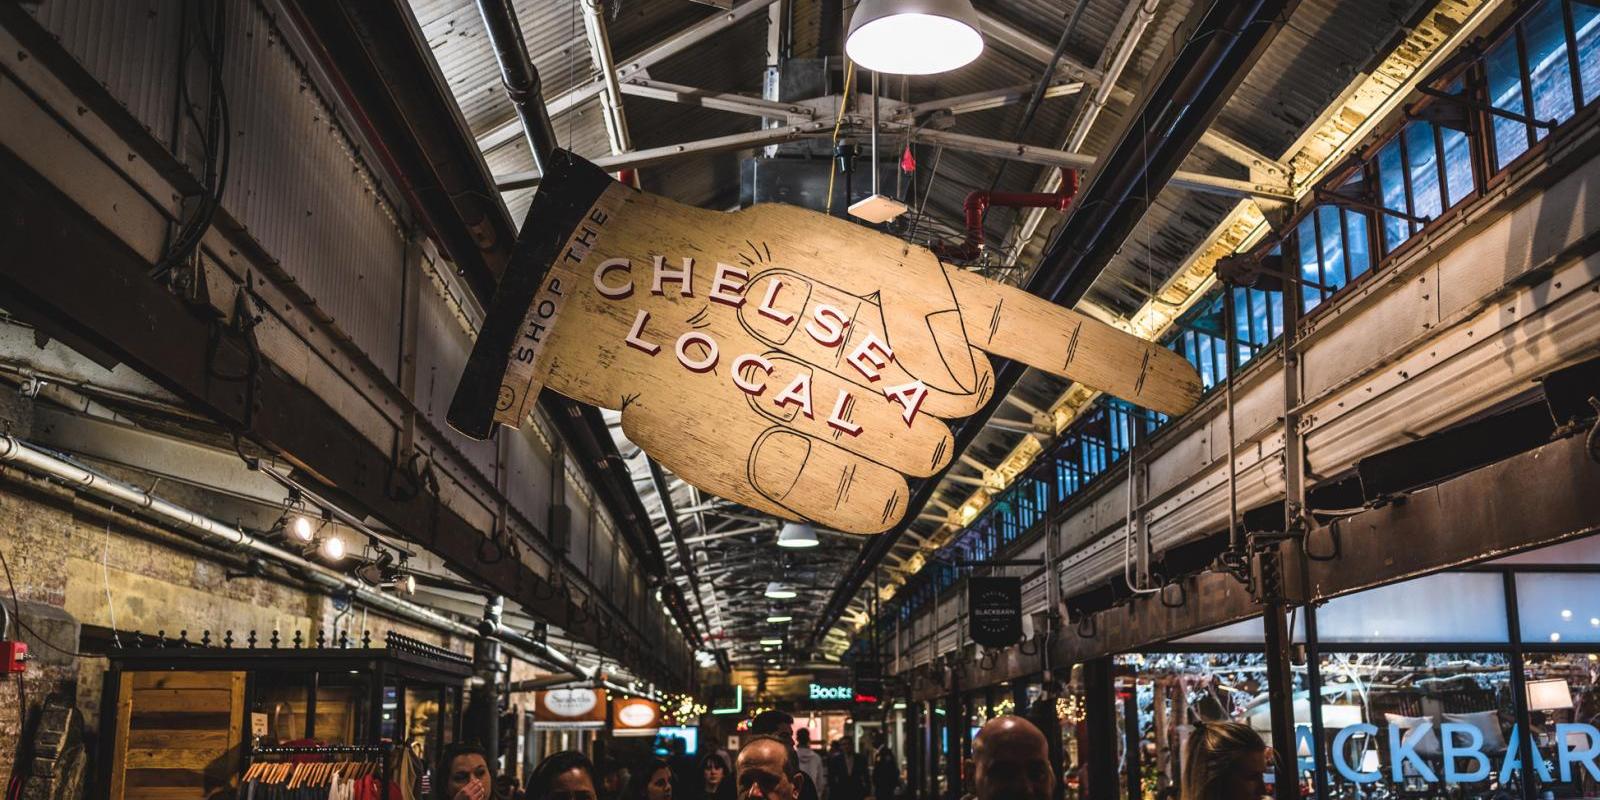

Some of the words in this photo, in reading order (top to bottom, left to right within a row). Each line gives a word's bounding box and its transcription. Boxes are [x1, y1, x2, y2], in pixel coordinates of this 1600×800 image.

[517, 278, 563, 365] SHOP
[563, 207, 608, 264] THE
[593, 255, 929, 427] CHELSEA
[625, 308, 864, 438] LOCAL
[975, 608, 1015, 616] BLACKBARN
[809, 683, 852, 699] Books
[1263, 722, 1600, 784] ACKBAR
